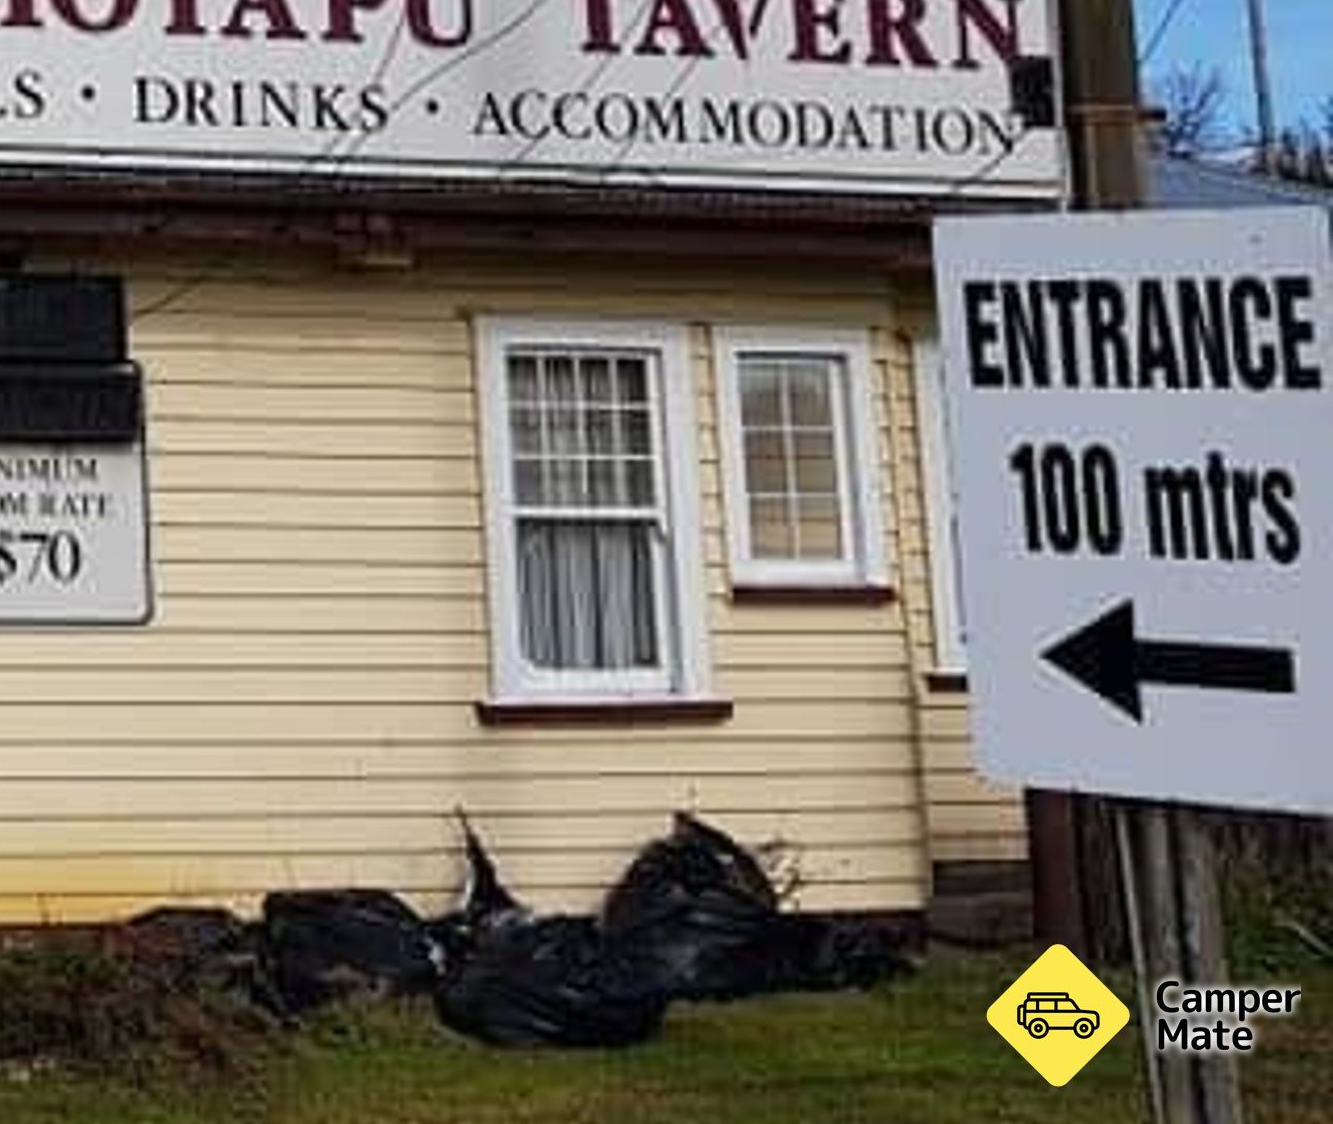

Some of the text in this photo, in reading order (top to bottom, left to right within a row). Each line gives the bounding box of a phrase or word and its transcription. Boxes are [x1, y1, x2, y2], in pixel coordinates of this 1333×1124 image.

[133, 76, 387, 133] DRINKS
[473, 92, 1025, 156] ACCOMMODATION
[963, 277, 1322, 390] ENTRANCE
[37, 493, 109, 519] RATE
[1009, 443, 1301, 564] 100 mtrs
